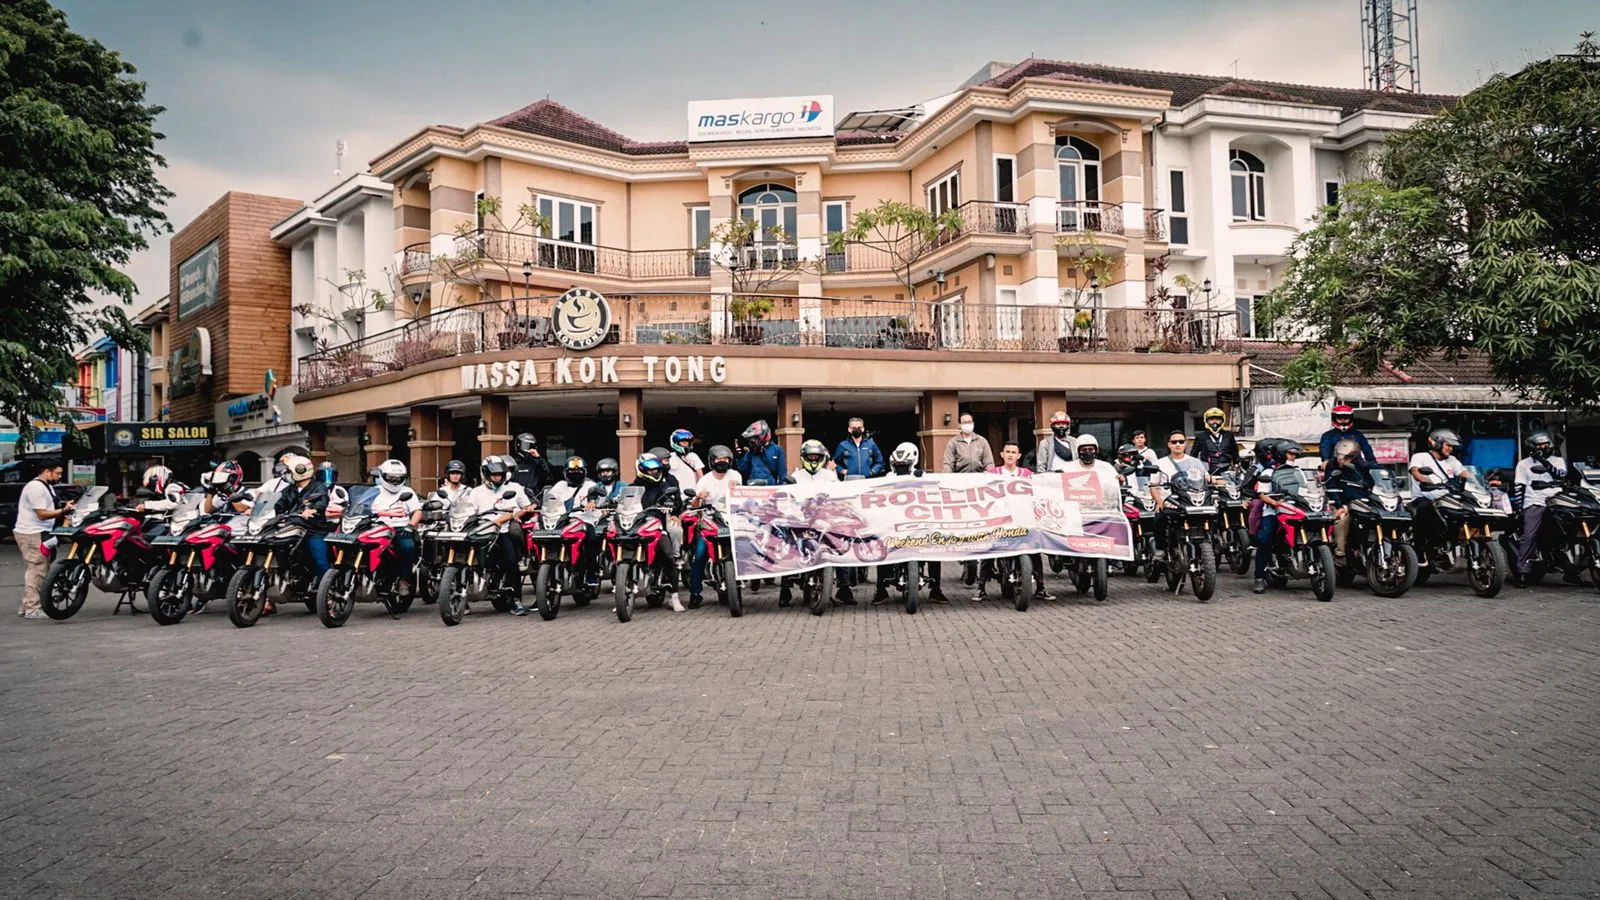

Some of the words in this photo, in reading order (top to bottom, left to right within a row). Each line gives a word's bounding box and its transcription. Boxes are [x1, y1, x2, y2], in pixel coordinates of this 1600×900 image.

[698, 110, 794, 127] maskargo
[557, 289, 600, 309] MASSA
[557, 330, 574, 347] KOK
[579, 328, 603, 348] TONG
[461, 360, 539, 390] MASSA
[557, 356, 619, 384] KOK
[643, 356, 727, 384] TONG
[141, 427, 164, 439] SIR
[168, 426, 208, 438] SALON
[861, 480, 1033, 509] ROLLING
[904, 501, 996, 521] CITY
[883, 532, 929, 549] Weekend
[991, 526, 1029, 540] Honda
